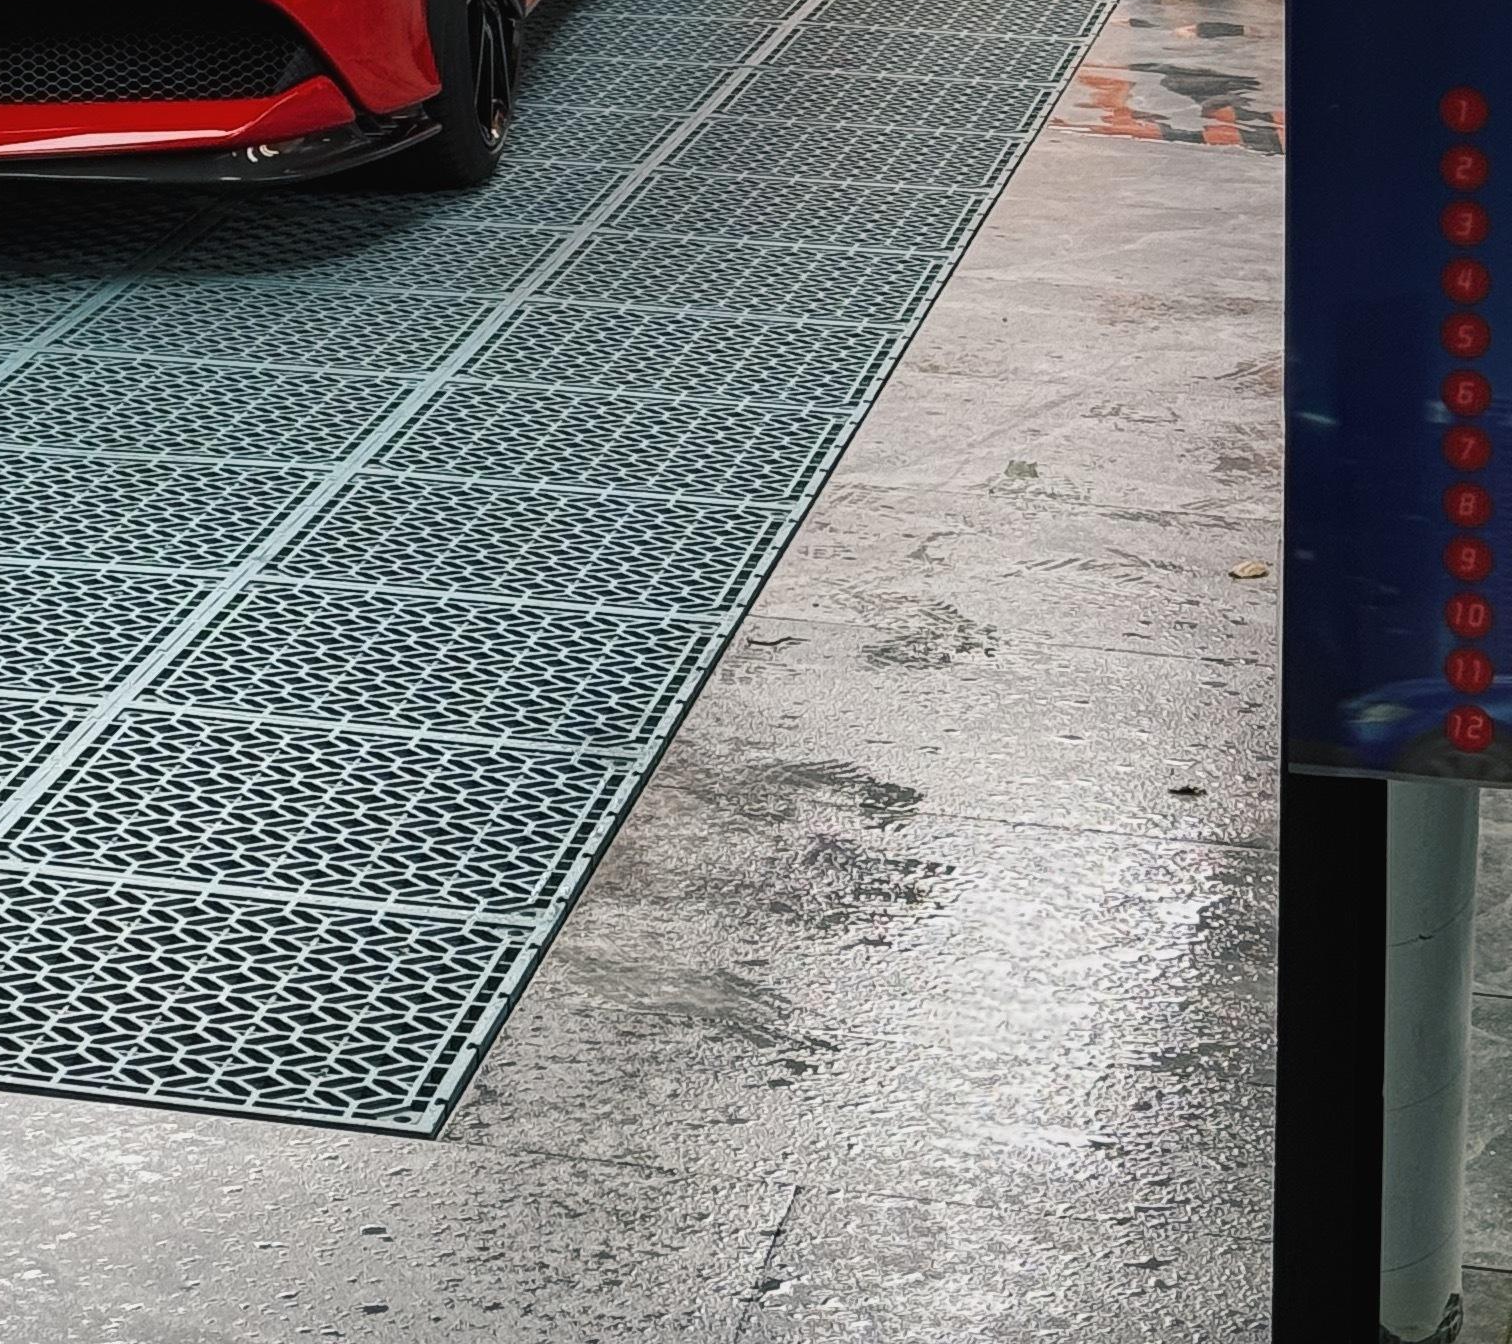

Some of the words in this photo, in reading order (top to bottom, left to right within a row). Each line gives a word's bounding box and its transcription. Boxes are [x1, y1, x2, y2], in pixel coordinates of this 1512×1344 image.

[1456, 156, 1472, 180] 2
[1456, 212, 1474, 235] 3
[1457, 268, 1473, 290] 4
[1457, 324, 1474, 349] 5
[1457, 381, 1474, 405] 6
[1458, 437, 1475, 460] 7
[1458, 492, 1476, 516] 8
[1460, 547, 1477, 571] 9
[1454, 603, 1485, 627] 10
[1454, 658, 1482, 683] 11
[1453, 715, 1484, 739] 12
